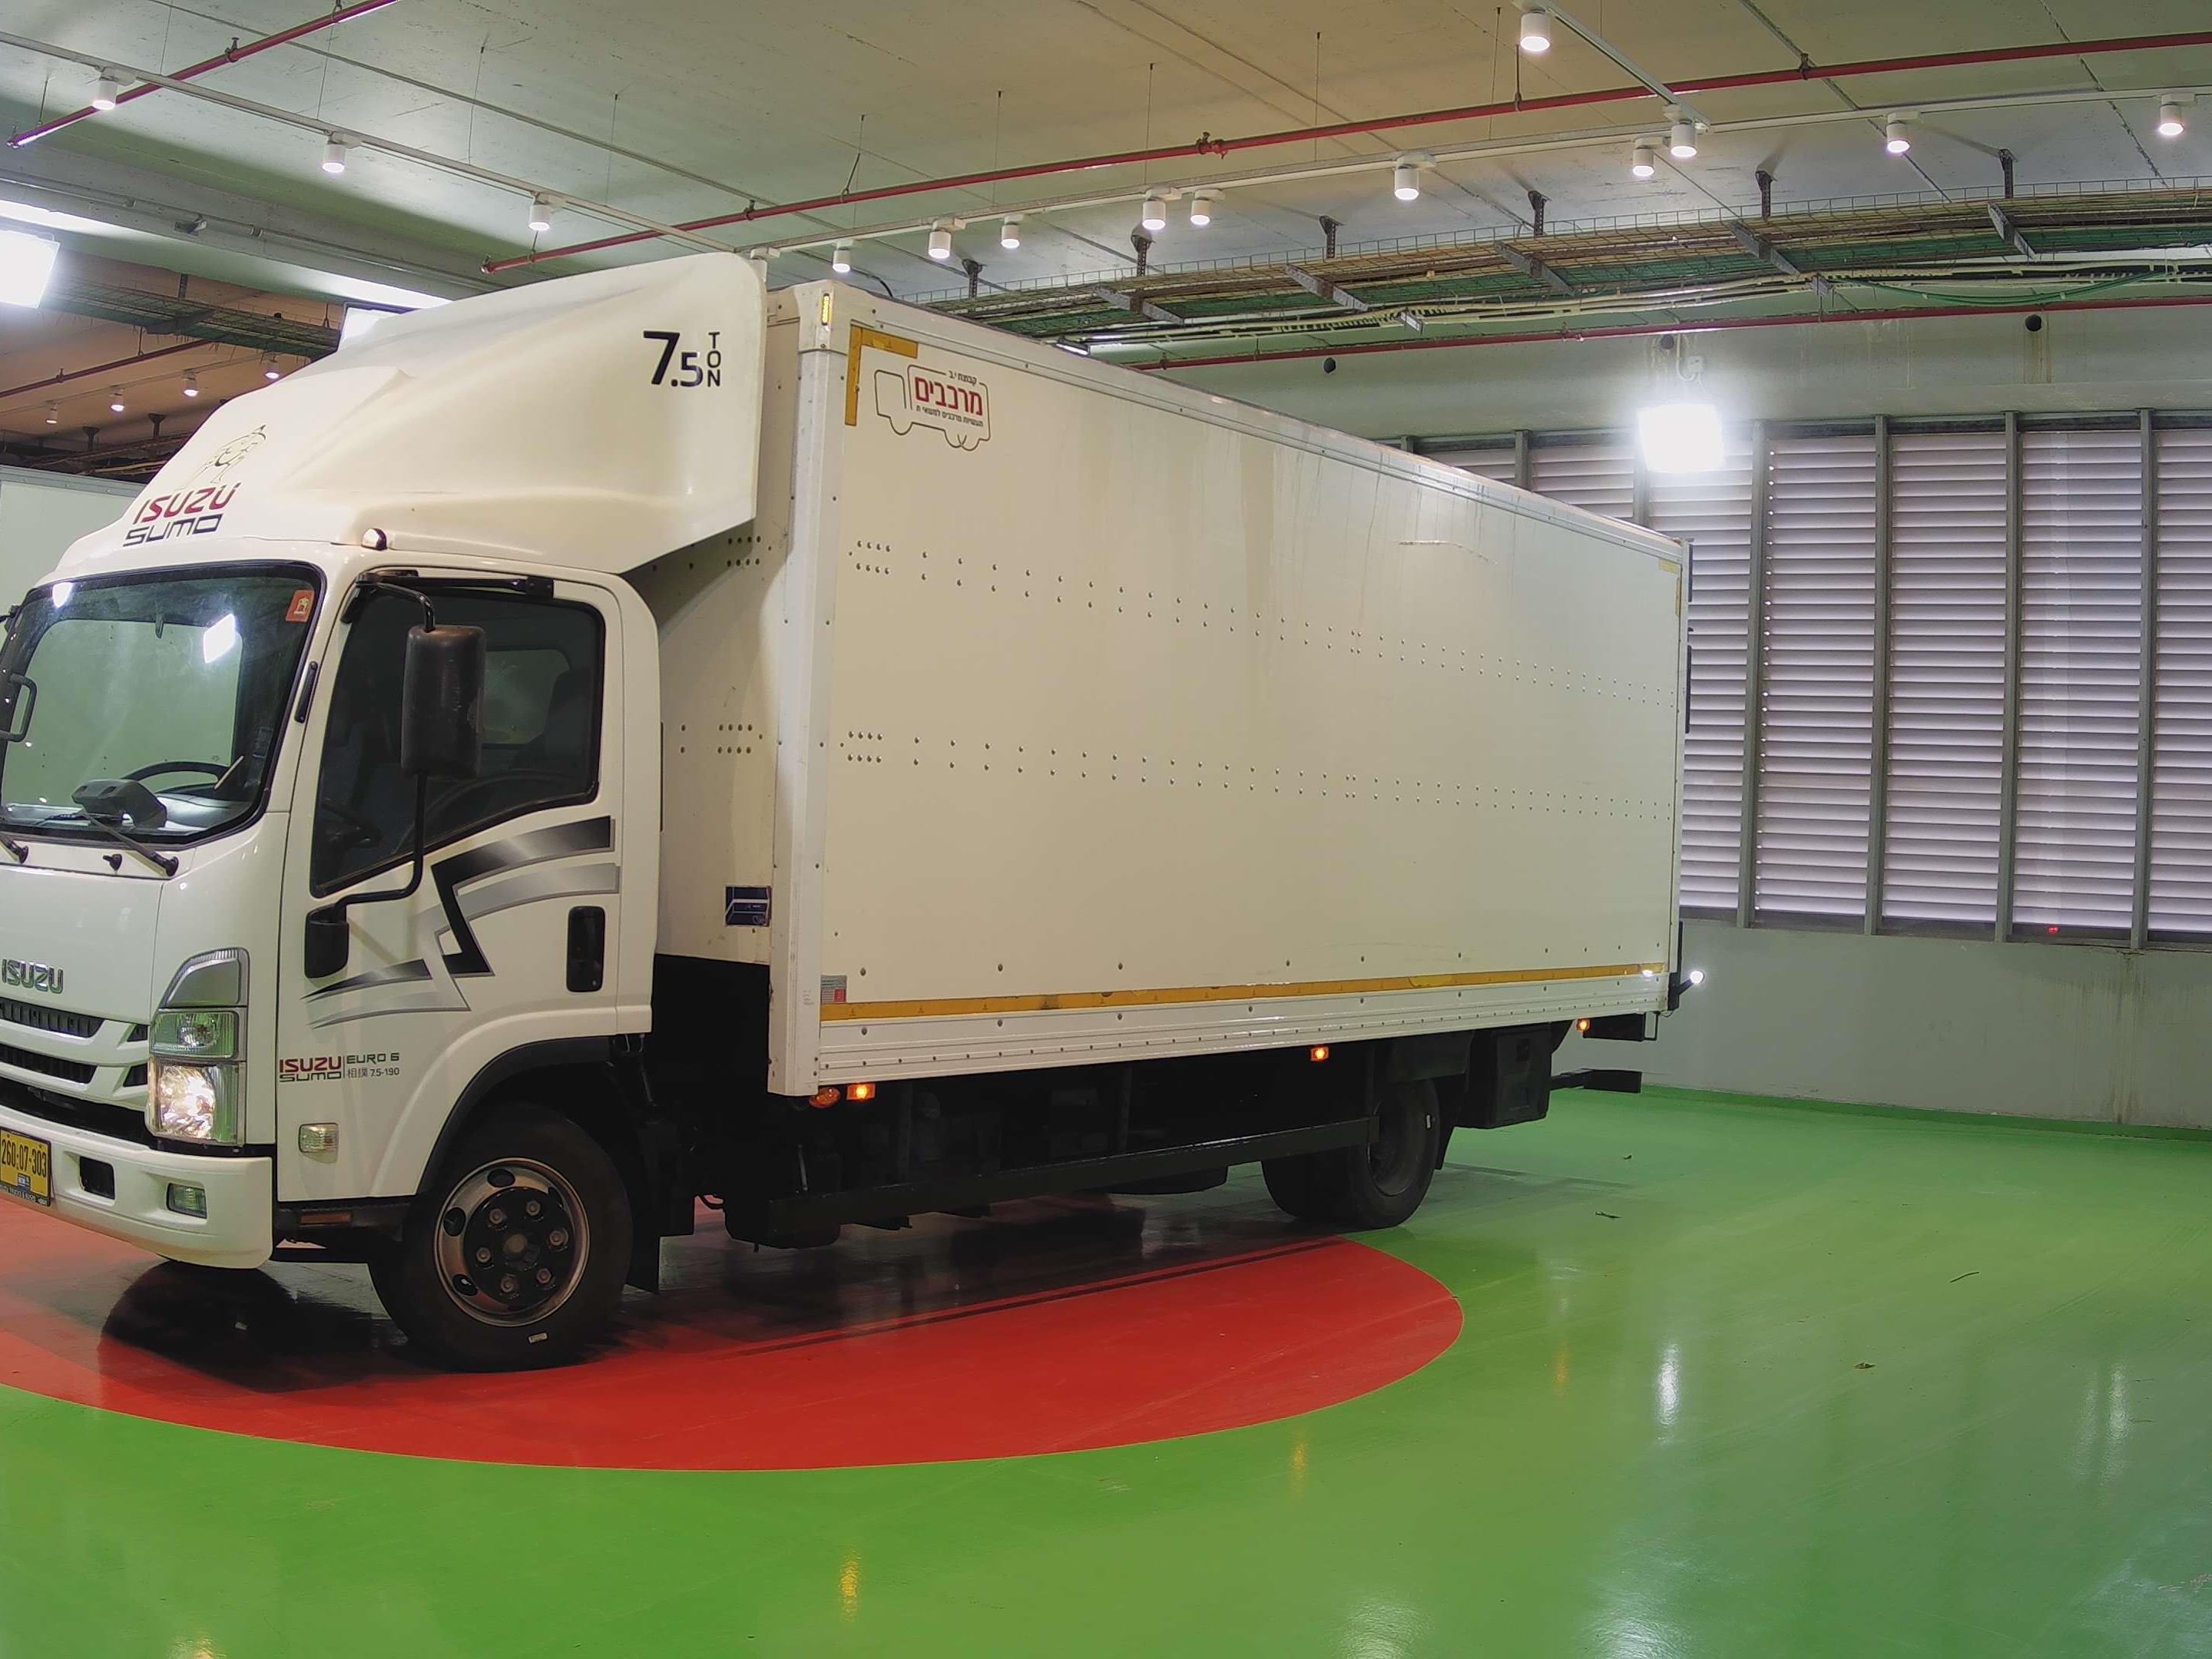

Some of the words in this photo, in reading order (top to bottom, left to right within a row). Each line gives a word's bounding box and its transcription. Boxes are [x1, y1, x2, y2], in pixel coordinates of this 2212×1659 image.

[643, 330, 704, 387] 7.5
[707, 331, 721, 388] TON
[915, 376, 983, 416] מרכבים
[133, 482, 242, 525] ISUZU
[123, 513, 224, 547] SUMO
[2, 958, 64, 995] ISUZU
[279, 1056, 342, 1073] ISUZU
[346, 1053, 386, 1065] EURO
[390, 1052, 399, 1061] 6
[279, 1071, 342, 1082] SUMO
